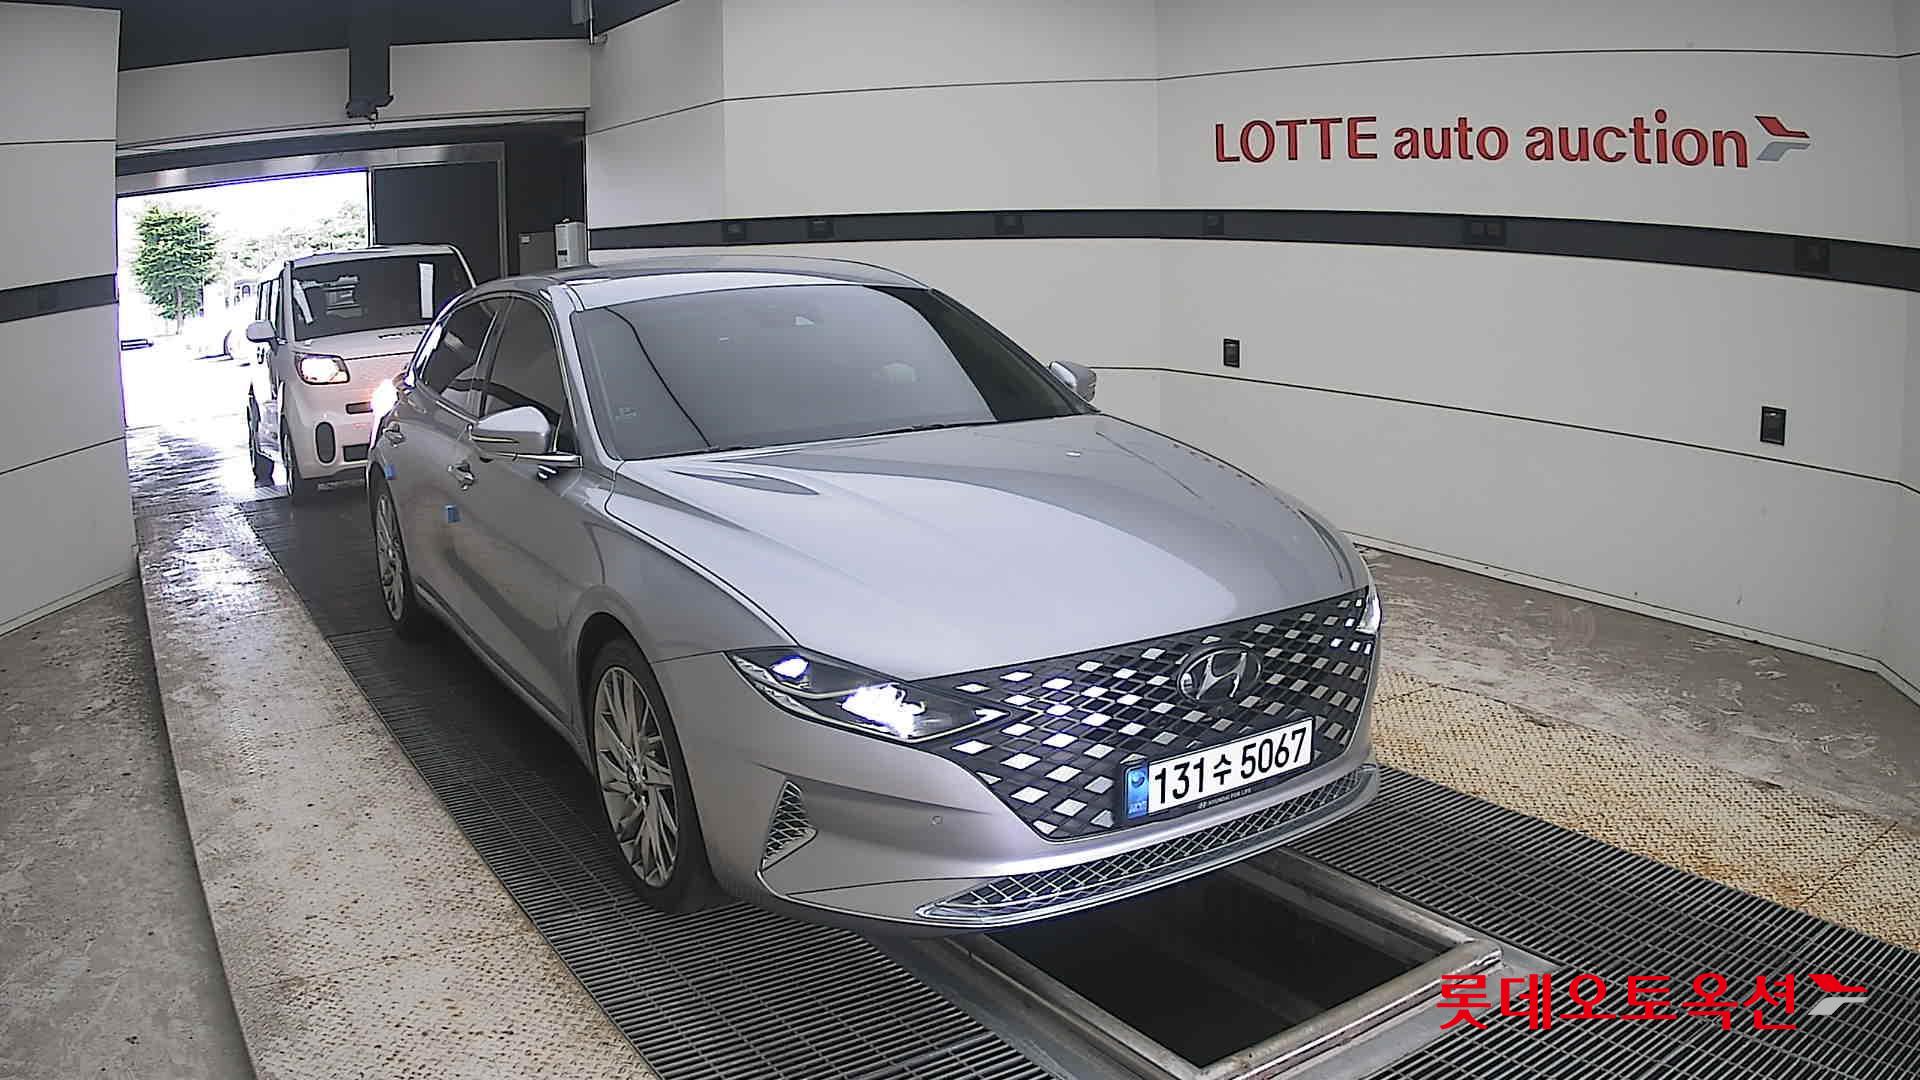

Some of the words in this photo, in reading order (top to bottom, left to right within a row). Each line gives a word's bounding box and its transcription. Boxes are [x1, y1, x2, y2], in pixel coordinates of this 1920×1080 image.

[1216, 117, 1378, 163] LOTTE
[1393, 117, 1509, 161] auto
[1525, 109, 1748, 168] auction
[1240, 727, 1307, 779] 5067
